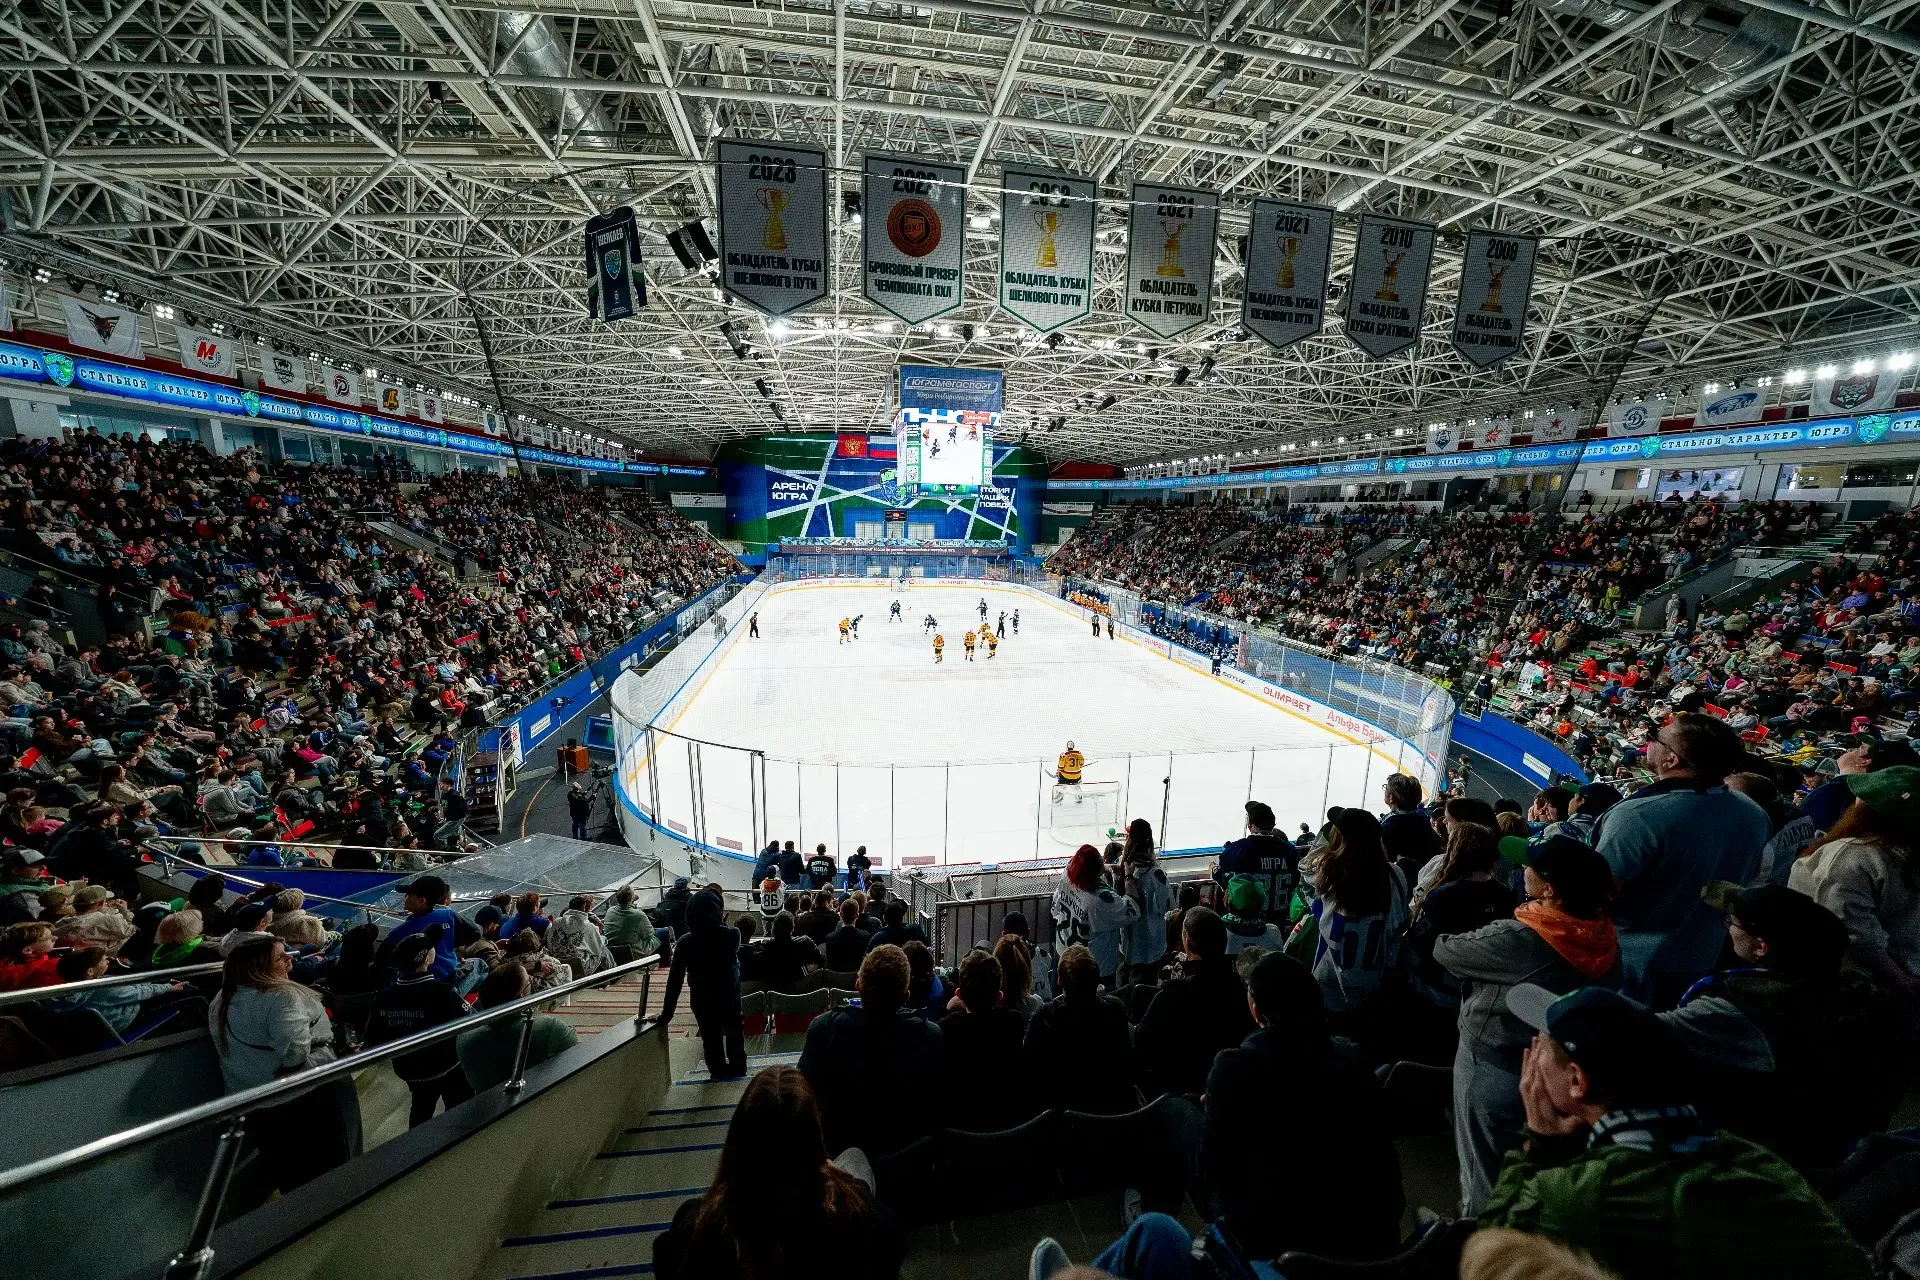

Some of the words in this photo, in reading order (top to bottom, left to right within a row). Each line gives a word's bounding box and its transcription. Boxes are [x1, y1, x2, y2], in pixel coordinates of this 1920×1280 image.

[868, 260, 923, 279] БРОНЗОВЫЙ
[925, 266, 959, 281] ПРИЗЕР
[874, 278, 933, 297] ЧЕМПИОНАТА
[934, 284, 952, 298] ВХЛ
[1005, 271, 1059, 288] ОБЛАДАТЕЛЬ
[1060, 276, 1087, 291] КУБКА
[1140, 279, 1198, 297] ОБЛАДАТЕЛЬ
[1009, 288, 1059, 305] ШЕЛКОВОГО
[1060, 293, 1082, 307] ПУТИ
[1132, 298, 1162, 314] КУБКА
[1163, 301, 1203, 317] ПЕТРОВА
[80, 368, 148, 389] СТАЛЬНОЙ
[216, 394, 243, 406] ЮГРА
[1661, 437, 1722, 449] СТАЛЬНОЙ
[1810, 426, 1850, 438] ЮГРА
[1611, 444, 1639, 453] ЮГРА
[771, 481, 815, 491] АРЕНА
[772, 491, 809, 501] ЮГРА
[1263, 686, 1312, 713] OLIMPBET
[1326, 710, 1360, 732] Альфа
[1260, 857, 1288, 870] ЮГРА
[763, 894, 778, 907] 86
